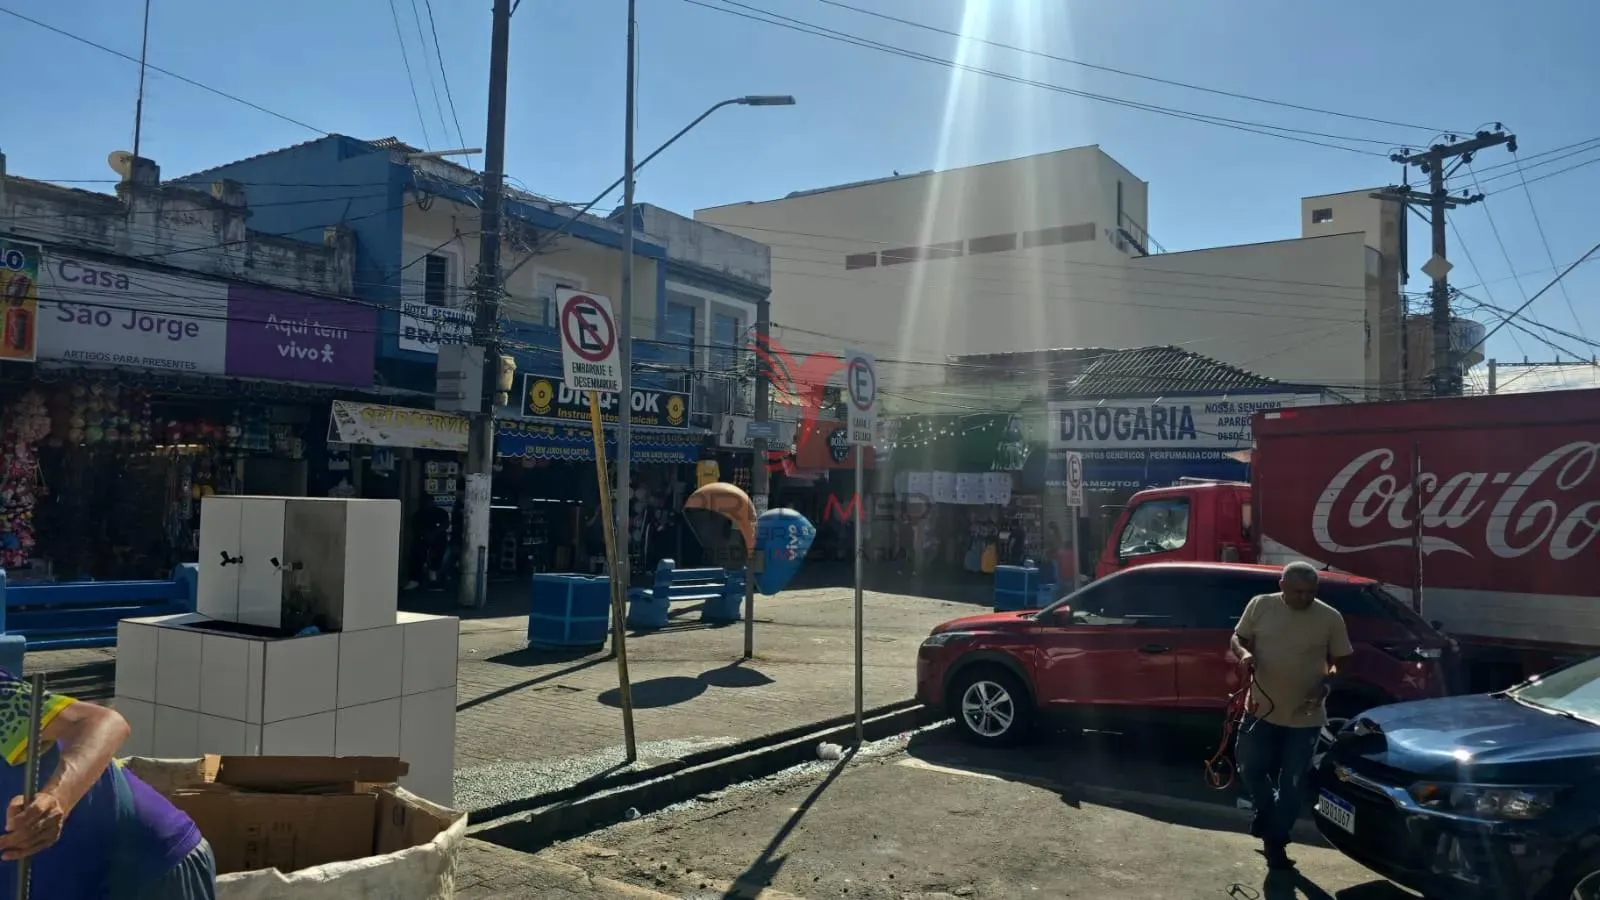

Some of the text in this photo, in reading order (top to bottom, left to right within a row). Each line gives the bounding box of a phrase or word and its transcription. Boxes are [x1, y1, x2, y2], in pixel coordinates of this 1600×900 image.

[59, 259, 130, 290] Casa
[121, 310, 200, 341] Jorge
[265, 313, 348, 340] Aqui tem
[575, 305, 602, 351] E
[63, 350, 197, 370] ARTIGOS PARA PRESENTES
[277, 340, 319, 361] vivo
[572, 362, 613, 378] EMBARQUE E
[855, 366, 869, 402] E
[557, 382, 660, 413] DISQ-OK
[1204, 402, 1235, 413] NOSSA
[630, 416, 659, 425] usicais
[1060, 405, 1197, 441] DROGARIA
[1217, 431, 1244, 441] DESDE
[1149, 451, 1200, 460] PERFUMARIA
[1201, 451, 1220, 460] COM
